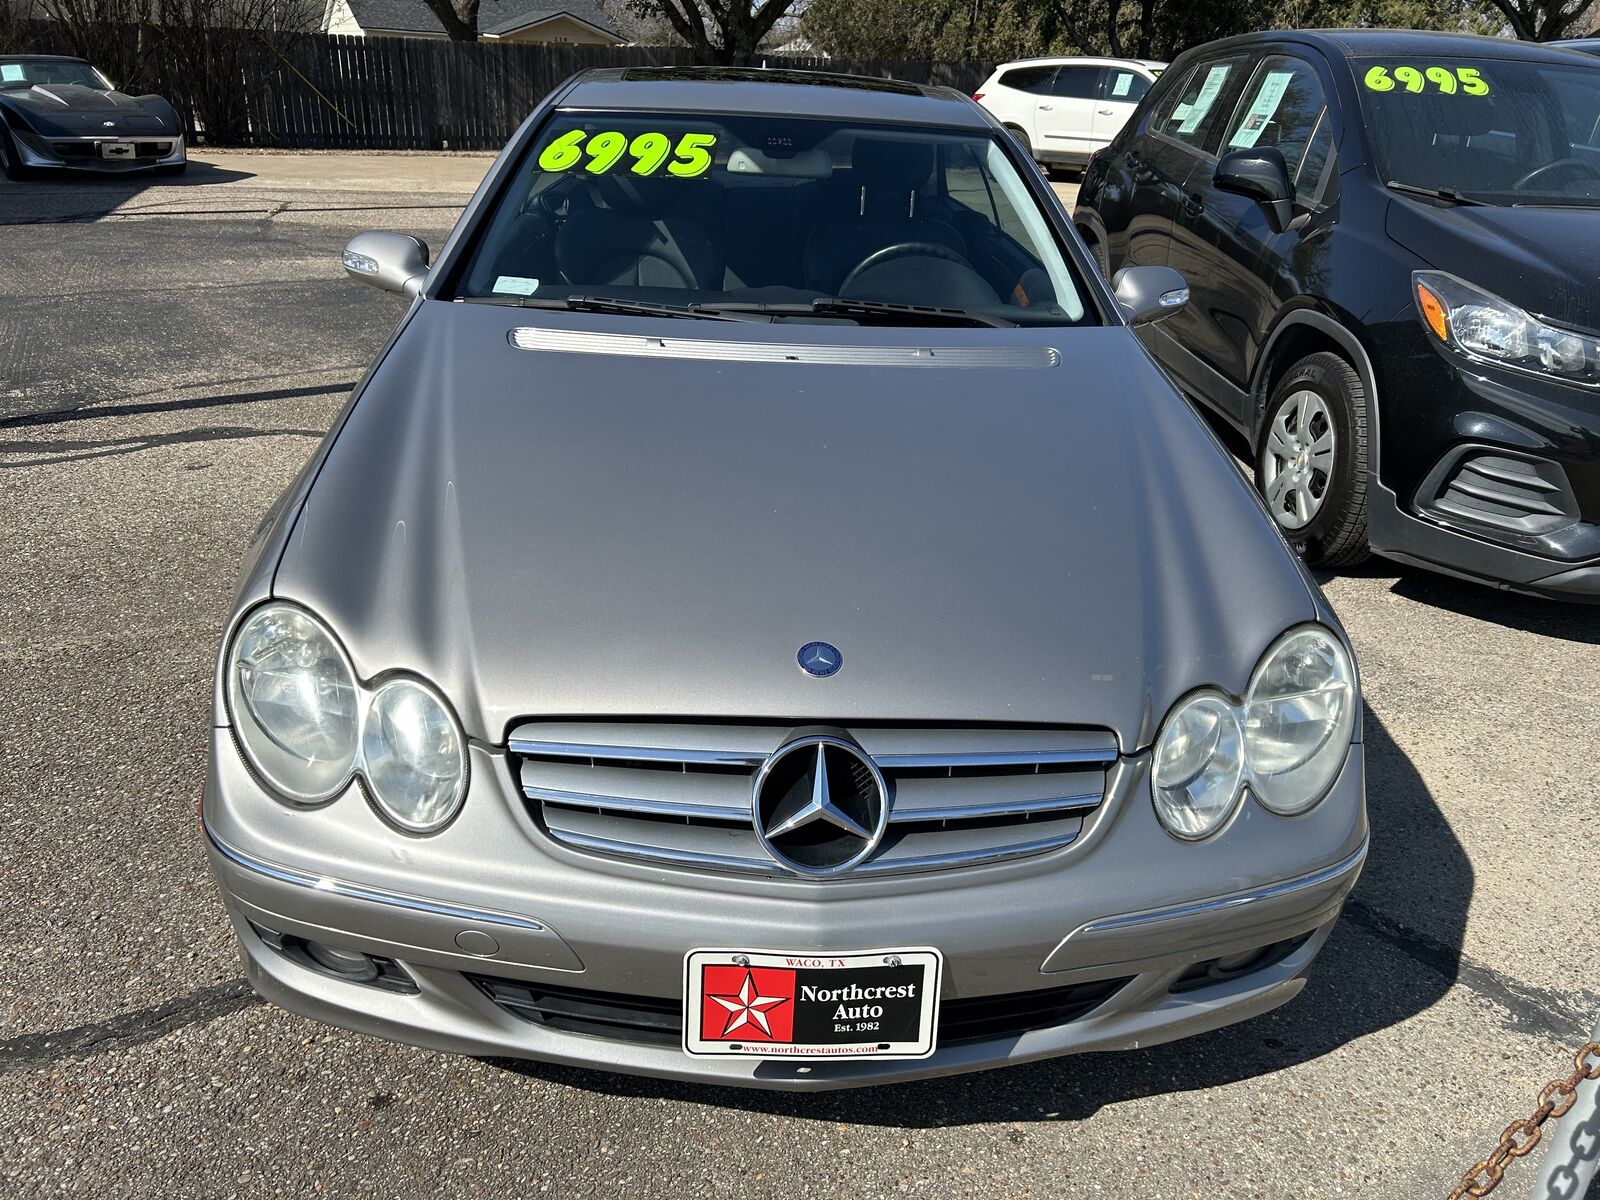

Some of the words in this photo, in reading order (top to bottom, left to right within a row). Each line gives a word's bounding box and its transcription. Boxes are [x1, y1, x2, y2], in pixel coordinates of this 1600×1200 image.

[1364, 65, 1490, 96] 6995
[538, 129, 717, 178] 6995
[785, 958, 824, 968] WACO,
[830, 959, 846, 968] TX
[800, 983, 916, 1002] Northcrest
[832, 1003, 884, 1020] Auto
[834, 1023, 853, 1032] Est.
[855, 1021, 880, 1031] 1982
[742, 1044, 879, 1055] www.northcrestautos.com
